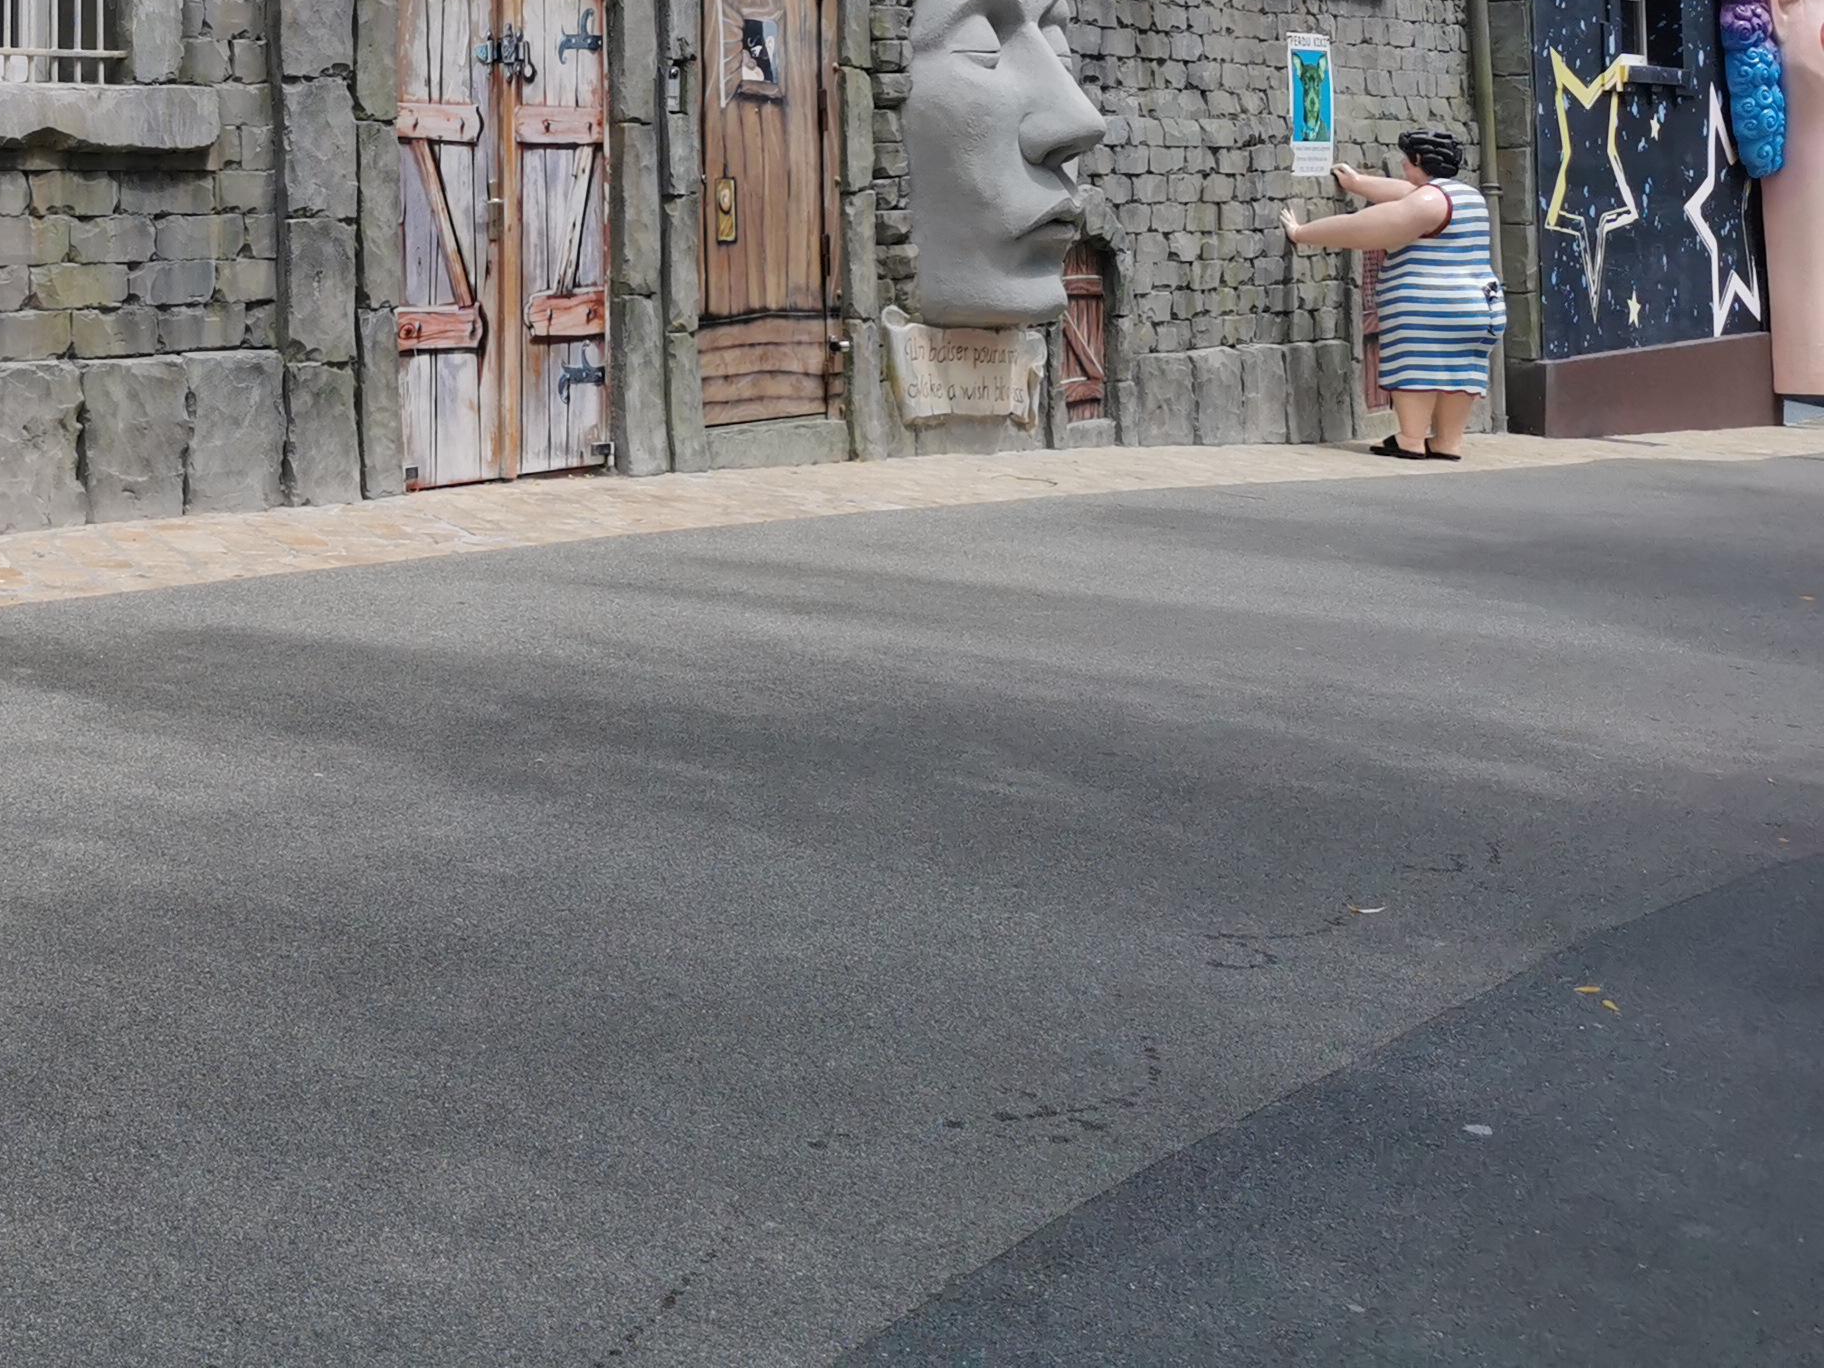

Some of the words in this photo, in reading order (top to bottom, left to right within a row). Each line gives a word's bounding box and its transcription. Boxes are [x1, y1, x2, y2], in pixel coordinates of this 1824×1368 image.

[1289, 35, 1311, 47] PERDU
[929, 341, 969, 363] baiser
[947, 385, 957, 401] a
[960, 375, 990, 401] wish
